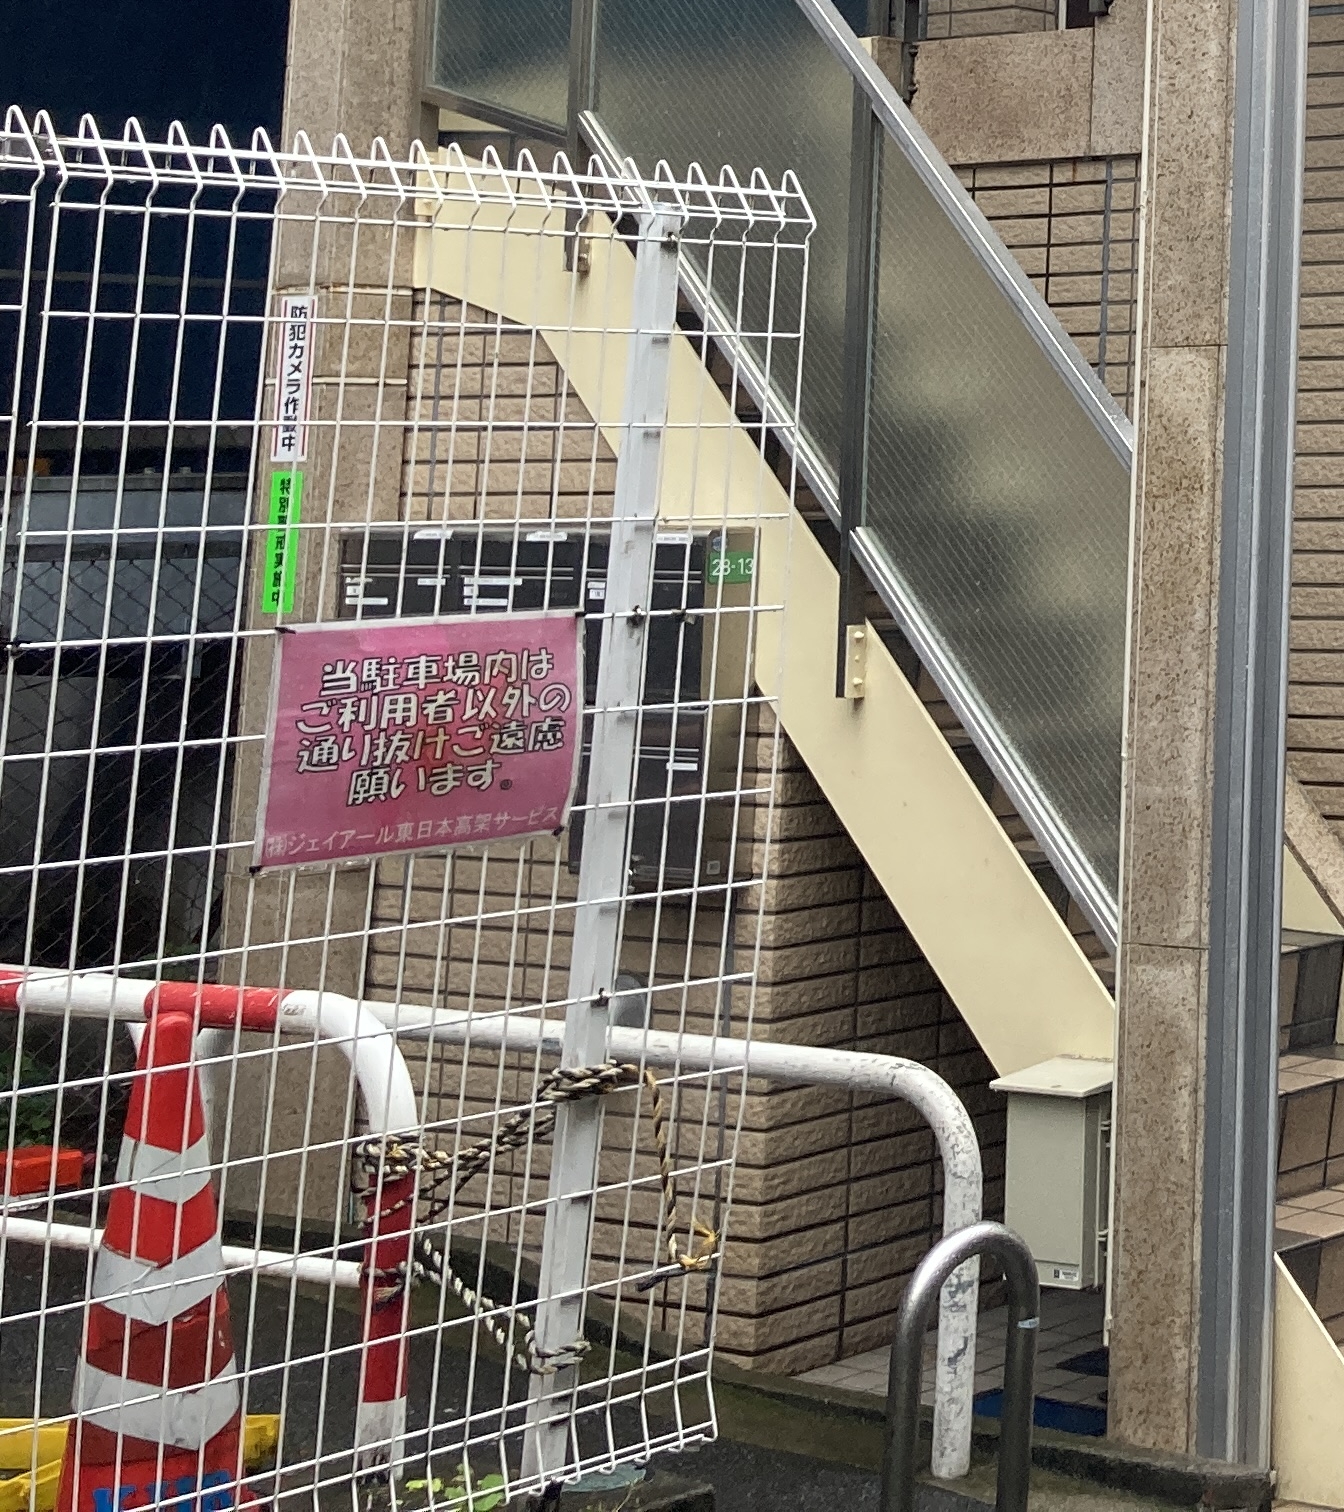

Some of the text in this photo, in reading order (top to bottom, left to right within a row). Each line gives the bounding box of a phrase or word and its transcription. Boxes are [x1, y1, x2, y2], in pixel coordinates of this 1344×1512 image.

[319, 649, 554, 697] 当駐車場内は
[297, 683, 571, 734] ご利用者以外の
[297, 717, 565, 774] 通り抜けご遠慮
[347, 759, 513, 807] 願います。
